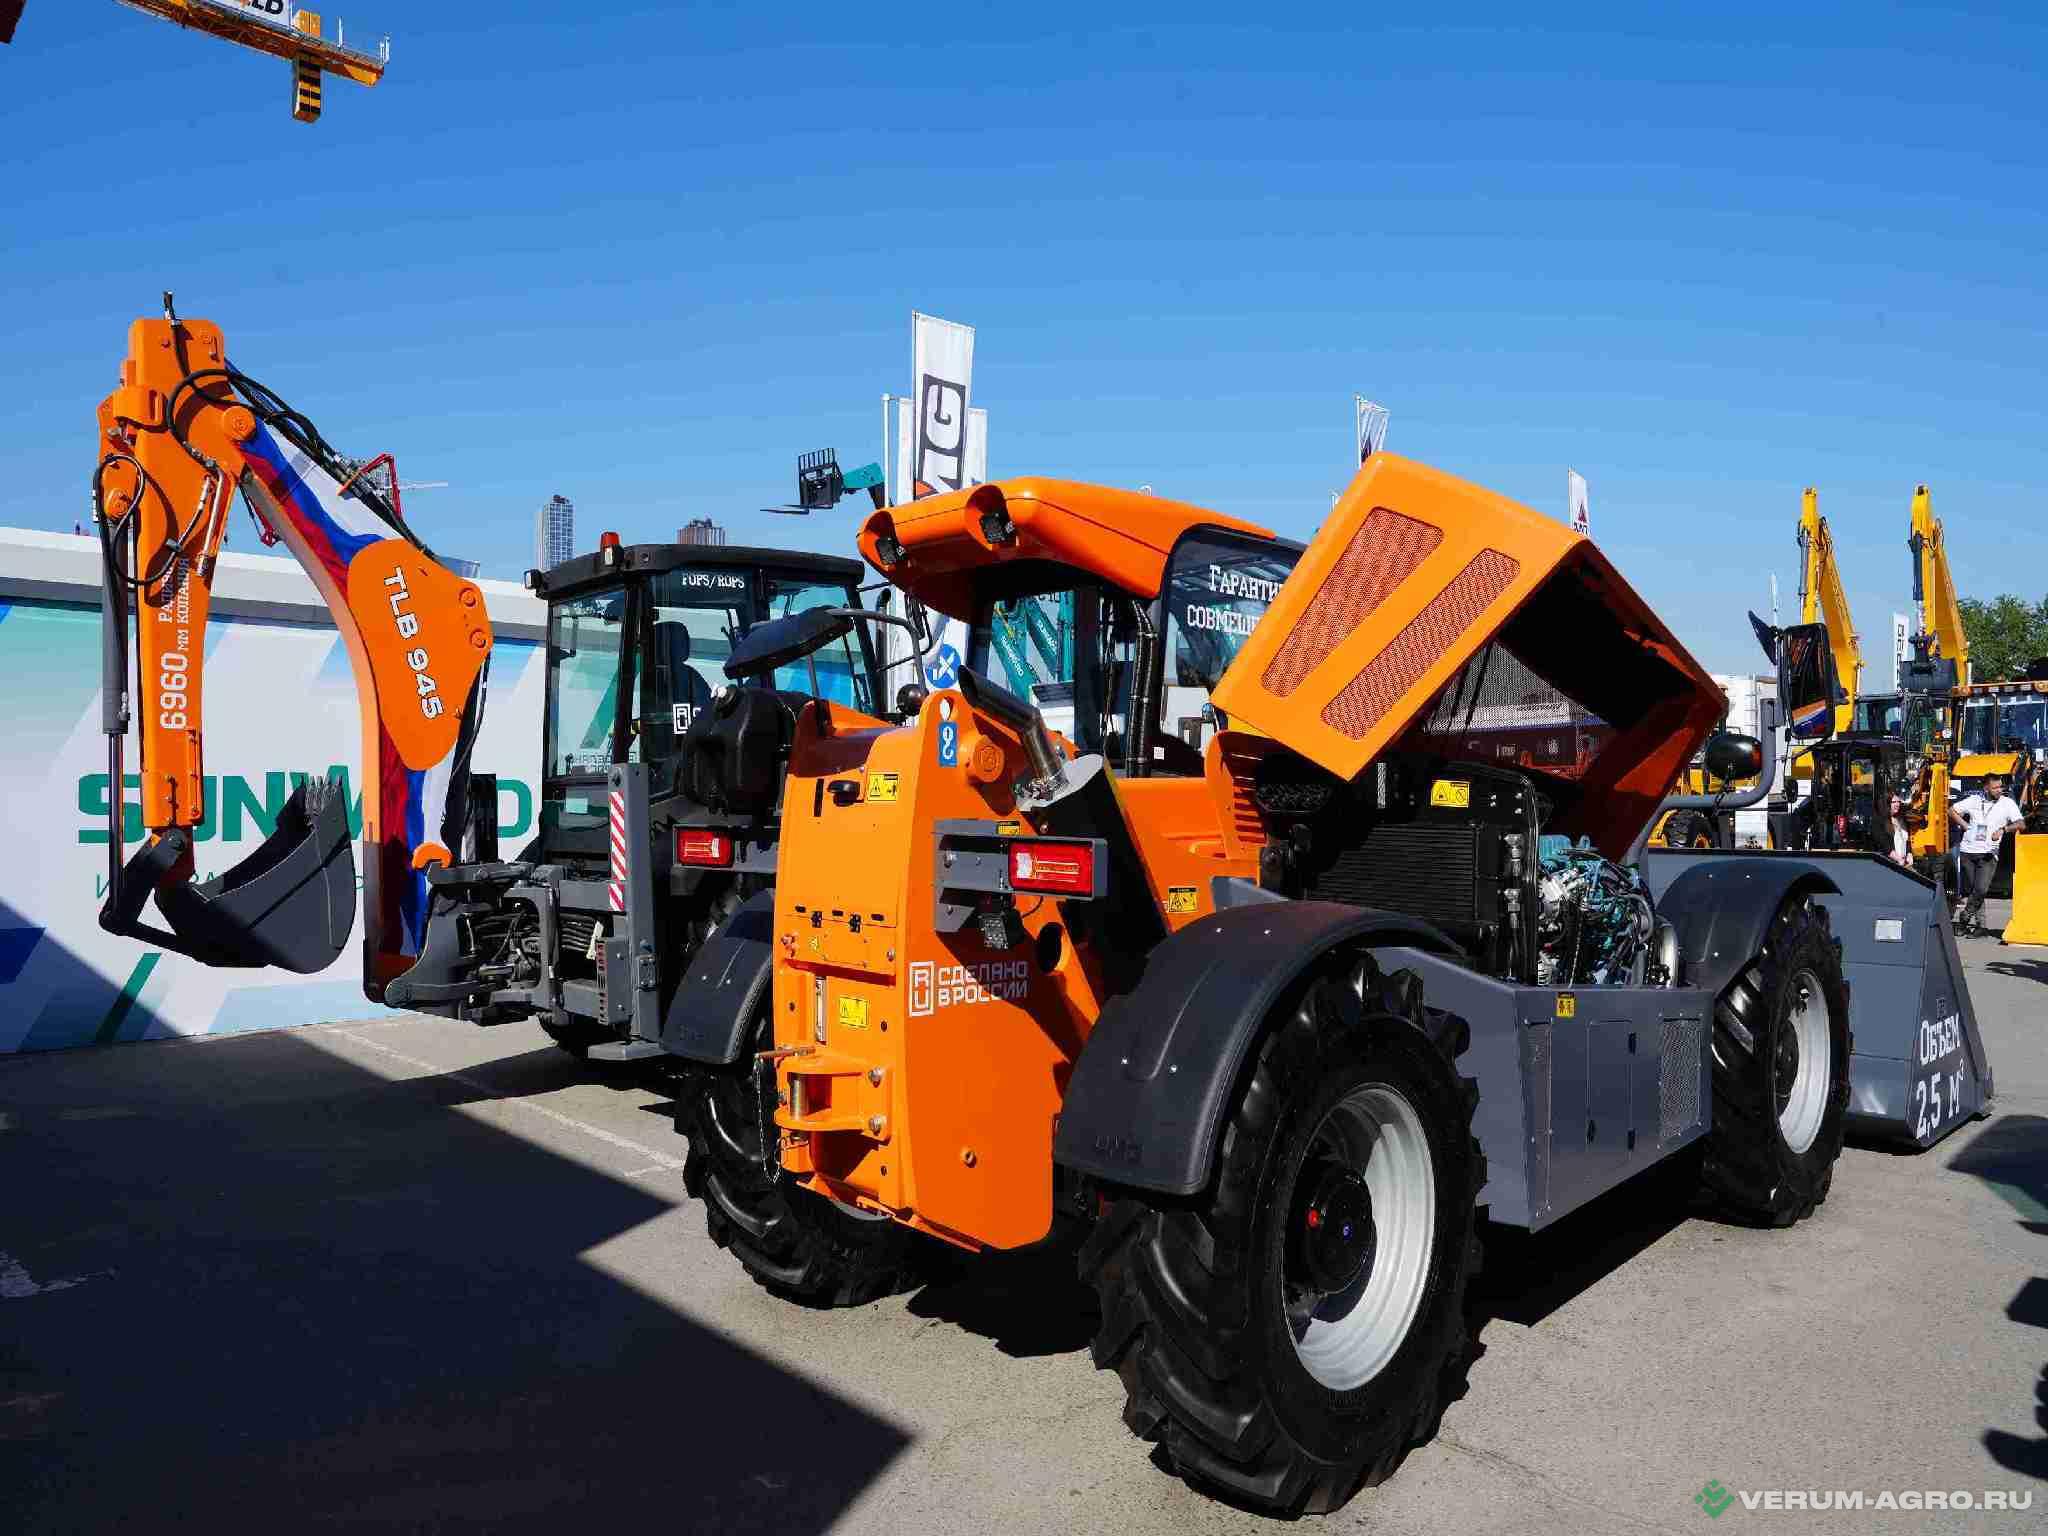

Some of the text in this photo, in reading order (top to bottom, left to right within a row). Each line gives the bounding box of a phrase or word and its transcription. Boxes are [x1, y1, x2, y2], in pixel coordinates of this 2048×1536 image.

[384, 566, 445, 720] TLB 945
[160, 652, 188, 729] 6960
[939, 961, 1028, 986] СДЕЛАНО
[1916, 1071, 1941, 1140] 2,5
